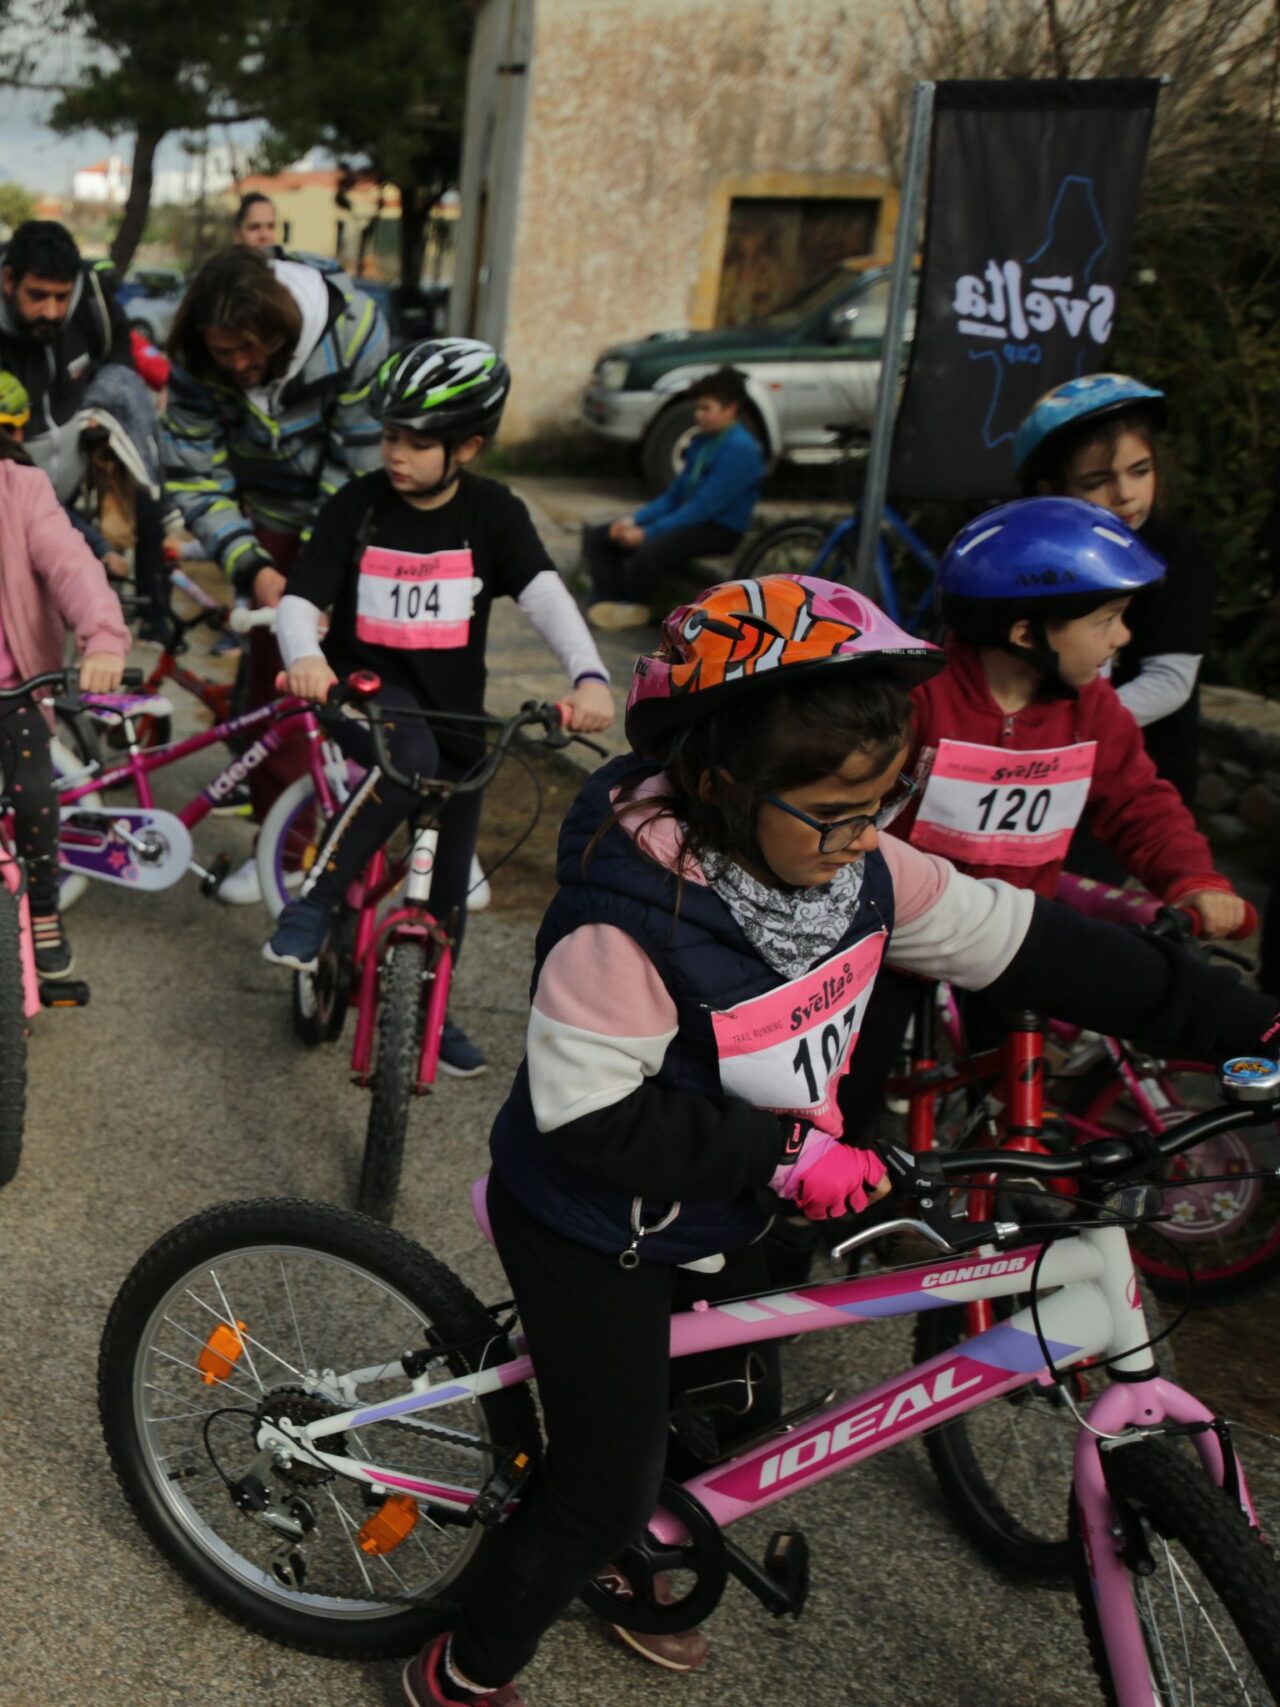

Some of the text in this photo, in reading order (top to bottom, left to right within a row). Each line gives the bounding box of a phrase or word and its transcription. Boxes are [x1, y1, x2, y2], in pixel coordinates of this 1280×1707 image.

[390, 583, 440, 618] 104
[977, 788, 1052, 833] 120
[732, 1020, 783, 1045] TRAIL RUNNING
[922, 1256, 1027, 1289] CONDOR
[758, 1367, 983, 1490] IDEAL
